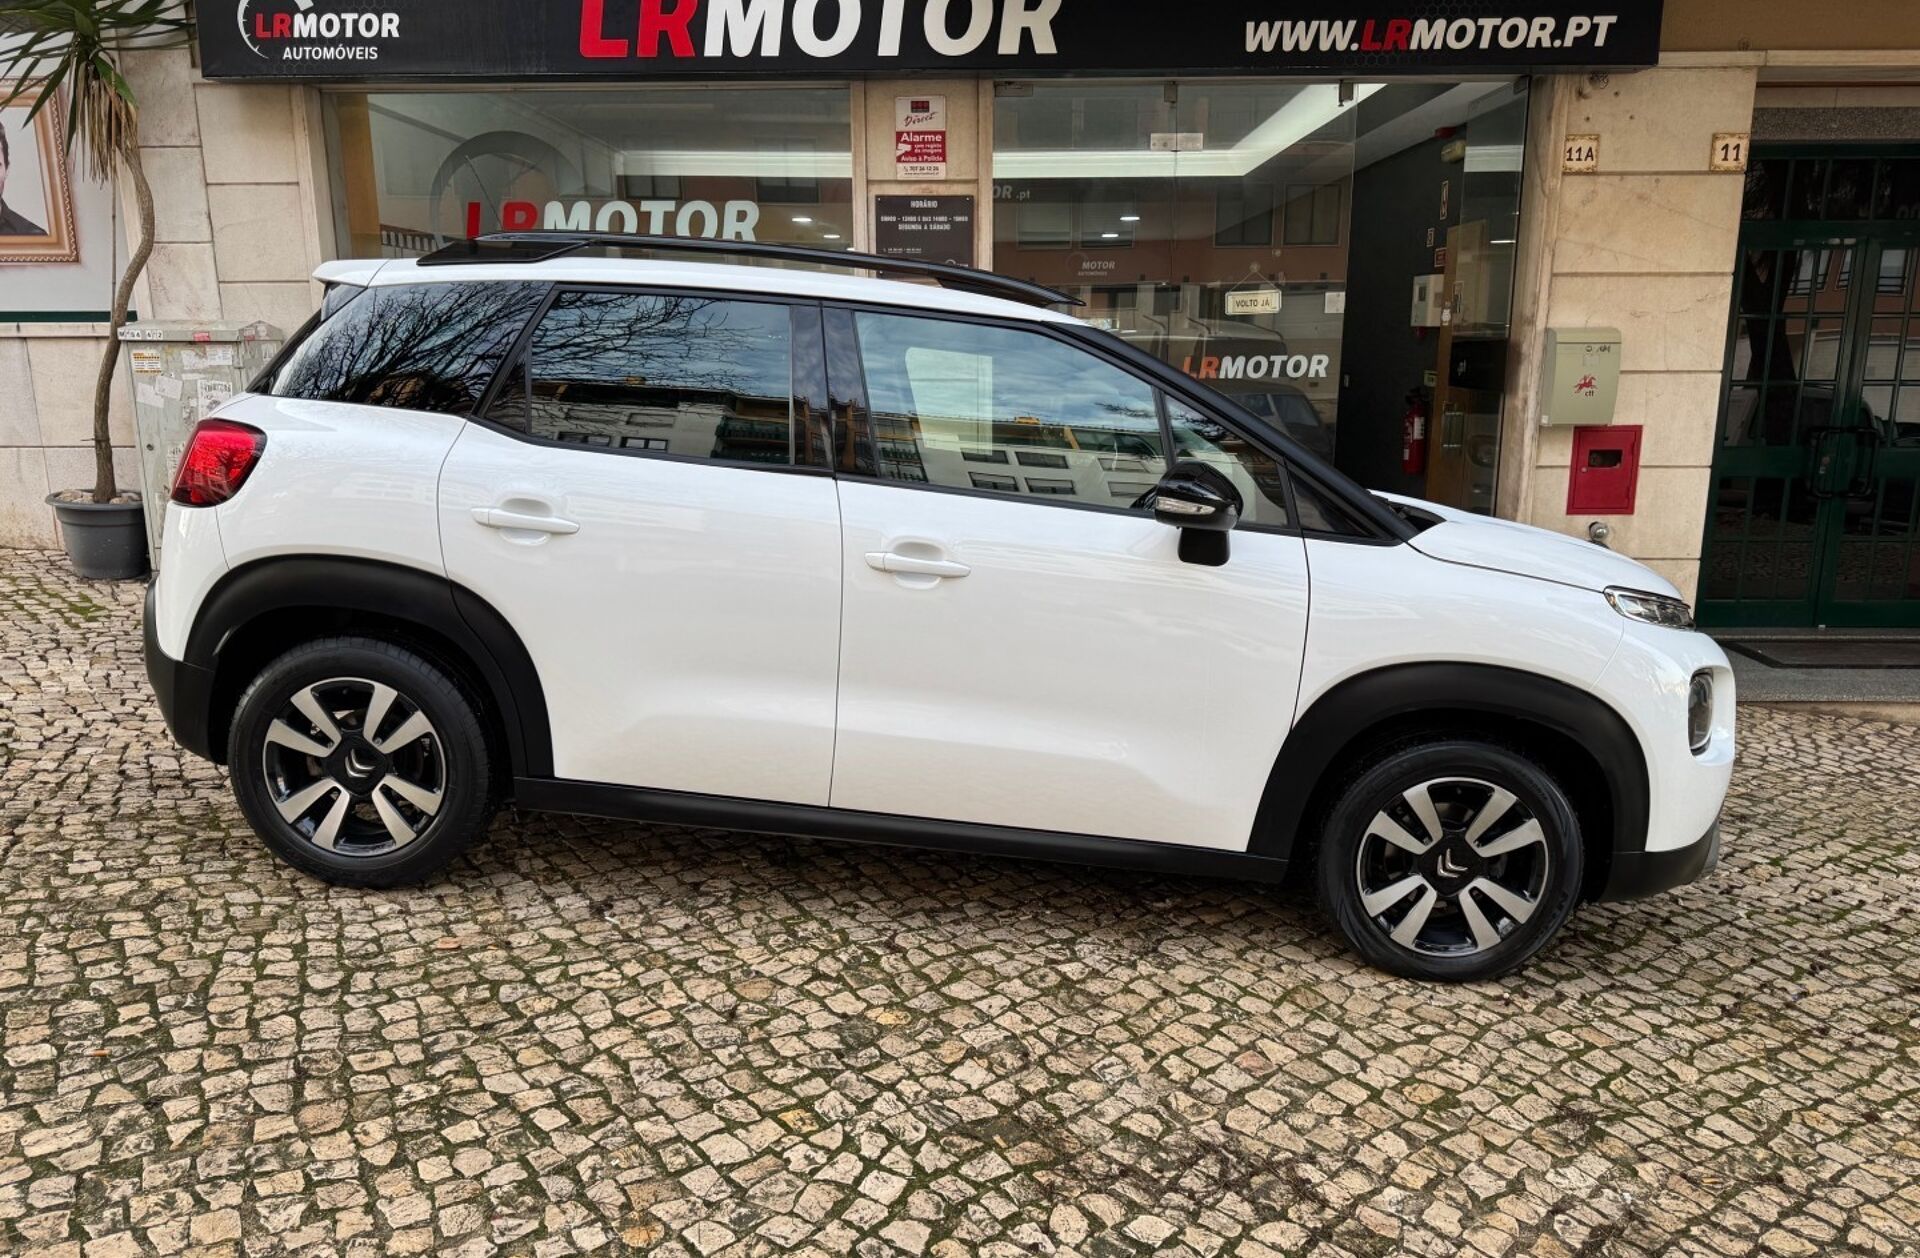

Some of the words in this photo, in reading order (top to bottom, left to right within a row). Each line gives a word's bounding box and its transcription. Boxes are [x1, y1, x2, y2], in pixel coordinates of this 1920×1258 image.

[255, 13, 400, 39] LRMOTOR
[579, 0, 1059, 59] LRMOTOR
[1245, 15, 1619, 53] WWW.LRMOTOR.PT
[282, 43, 379, 61] AUTOMÓVEIS
[900, 132, 943, 142] Alarme
[1565, 146, 1595, 163] 11A
[1720, 143, 1742, 162] 11
[910, 199, 938, 208] HORÁRIO
[1235, 299, 1258, 308] VOLTO
[1183, 354, 1330, 380] LRMOTOR
